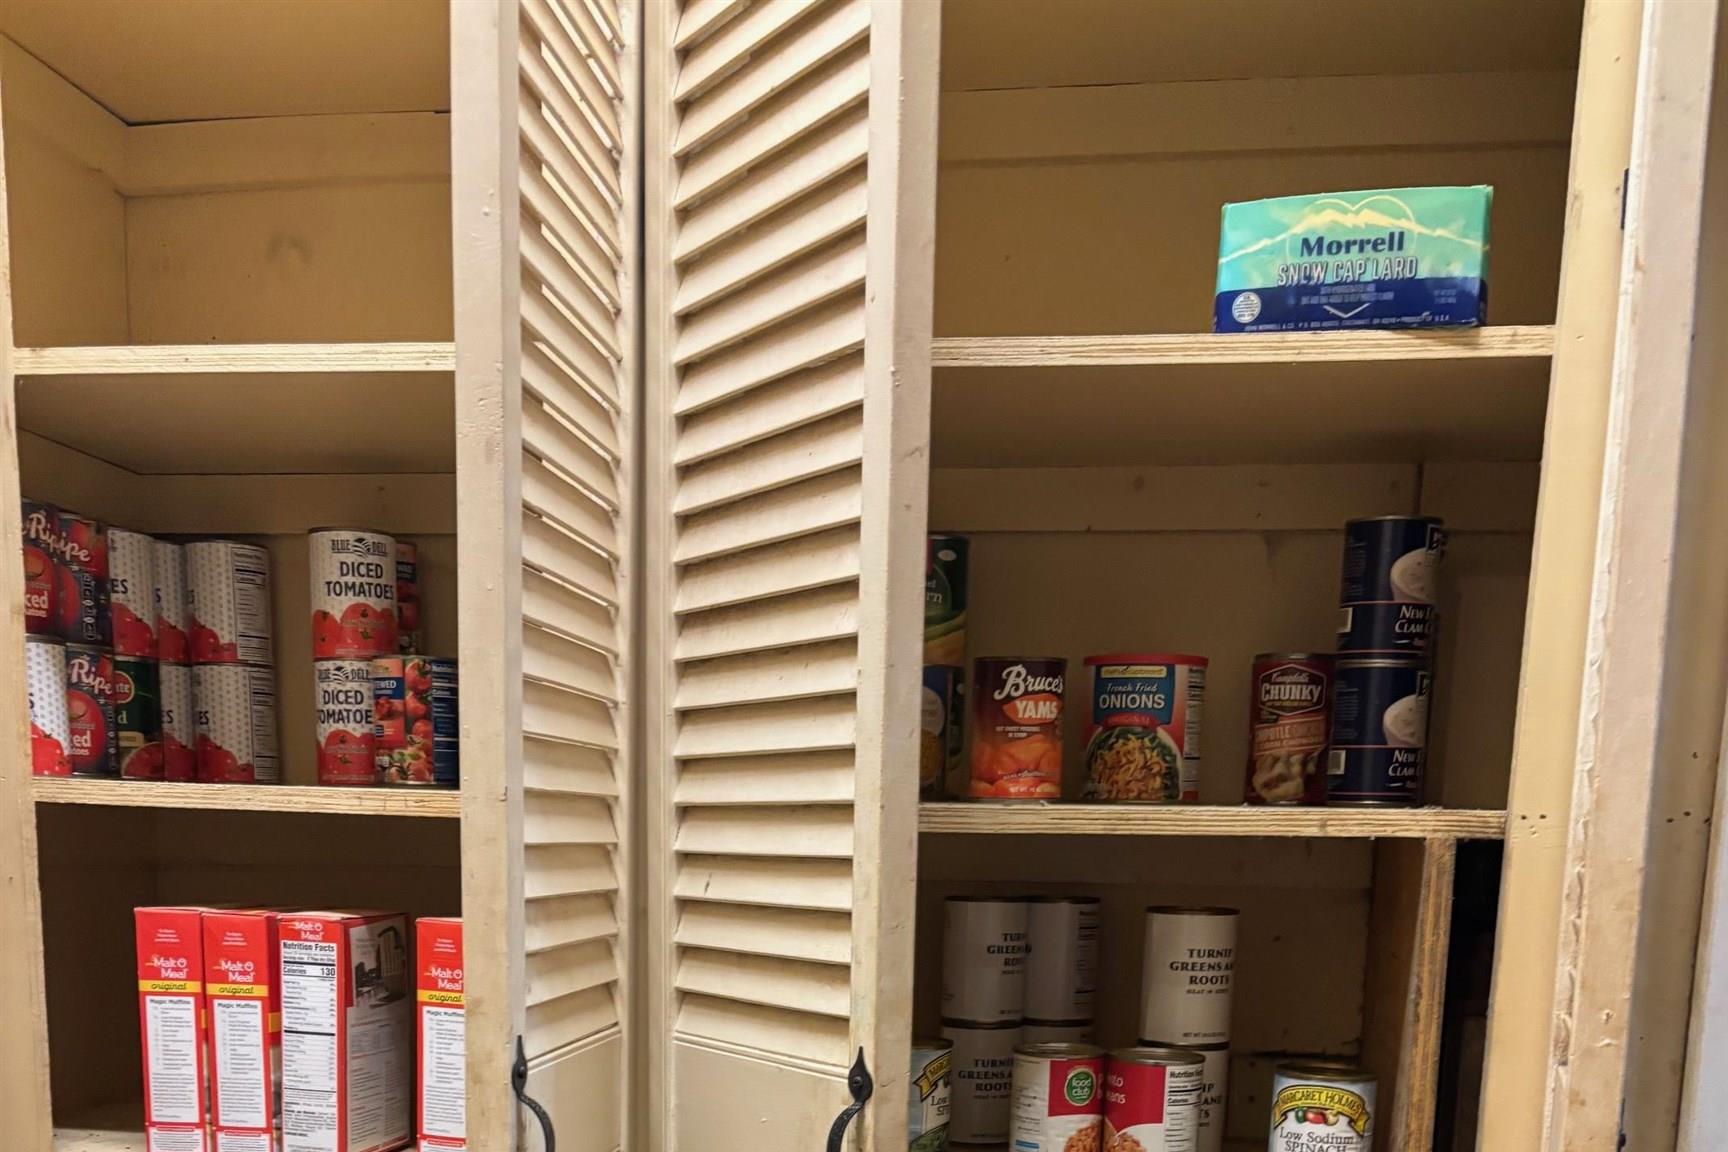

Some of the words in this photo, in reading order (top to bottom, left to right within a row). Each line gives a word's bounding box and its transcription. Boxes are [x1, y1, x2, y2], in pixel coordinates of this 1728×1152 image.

[1300, 231, 1405, 257] Morrell
[1277, 263, 1328, 287] SNOW
[1332, 261, 1367, 283] CAP
[1371, 257, 1418, 280] LARD
[340, 561, 383, 578] DICED
[993, 664, 1063, 700] Bruce's
[323, 690, 364, 705] DICED
[1099, 693, 1166, 709] ONIONS
[1261, 683, 1322, 703] CHUNKY
[317, 709, 372, 724] OMATOE
[1015, 700, 1058, 719] YAMS
[320, 968, 336, 977] 130
[1169, 961, 1222, 972] GREENS
[150, 982, 187, 991] original
[218, 985, 254, 995] original
[427, 993, 463, 1002] original
[958, 1070, 1004, 1080] GREENS
[1325, 1091, 1362, 1113] HOLMES
[1280, 1127, 1303, 1141] Low
[1307, 1131, 1354, 1145] Sodium
